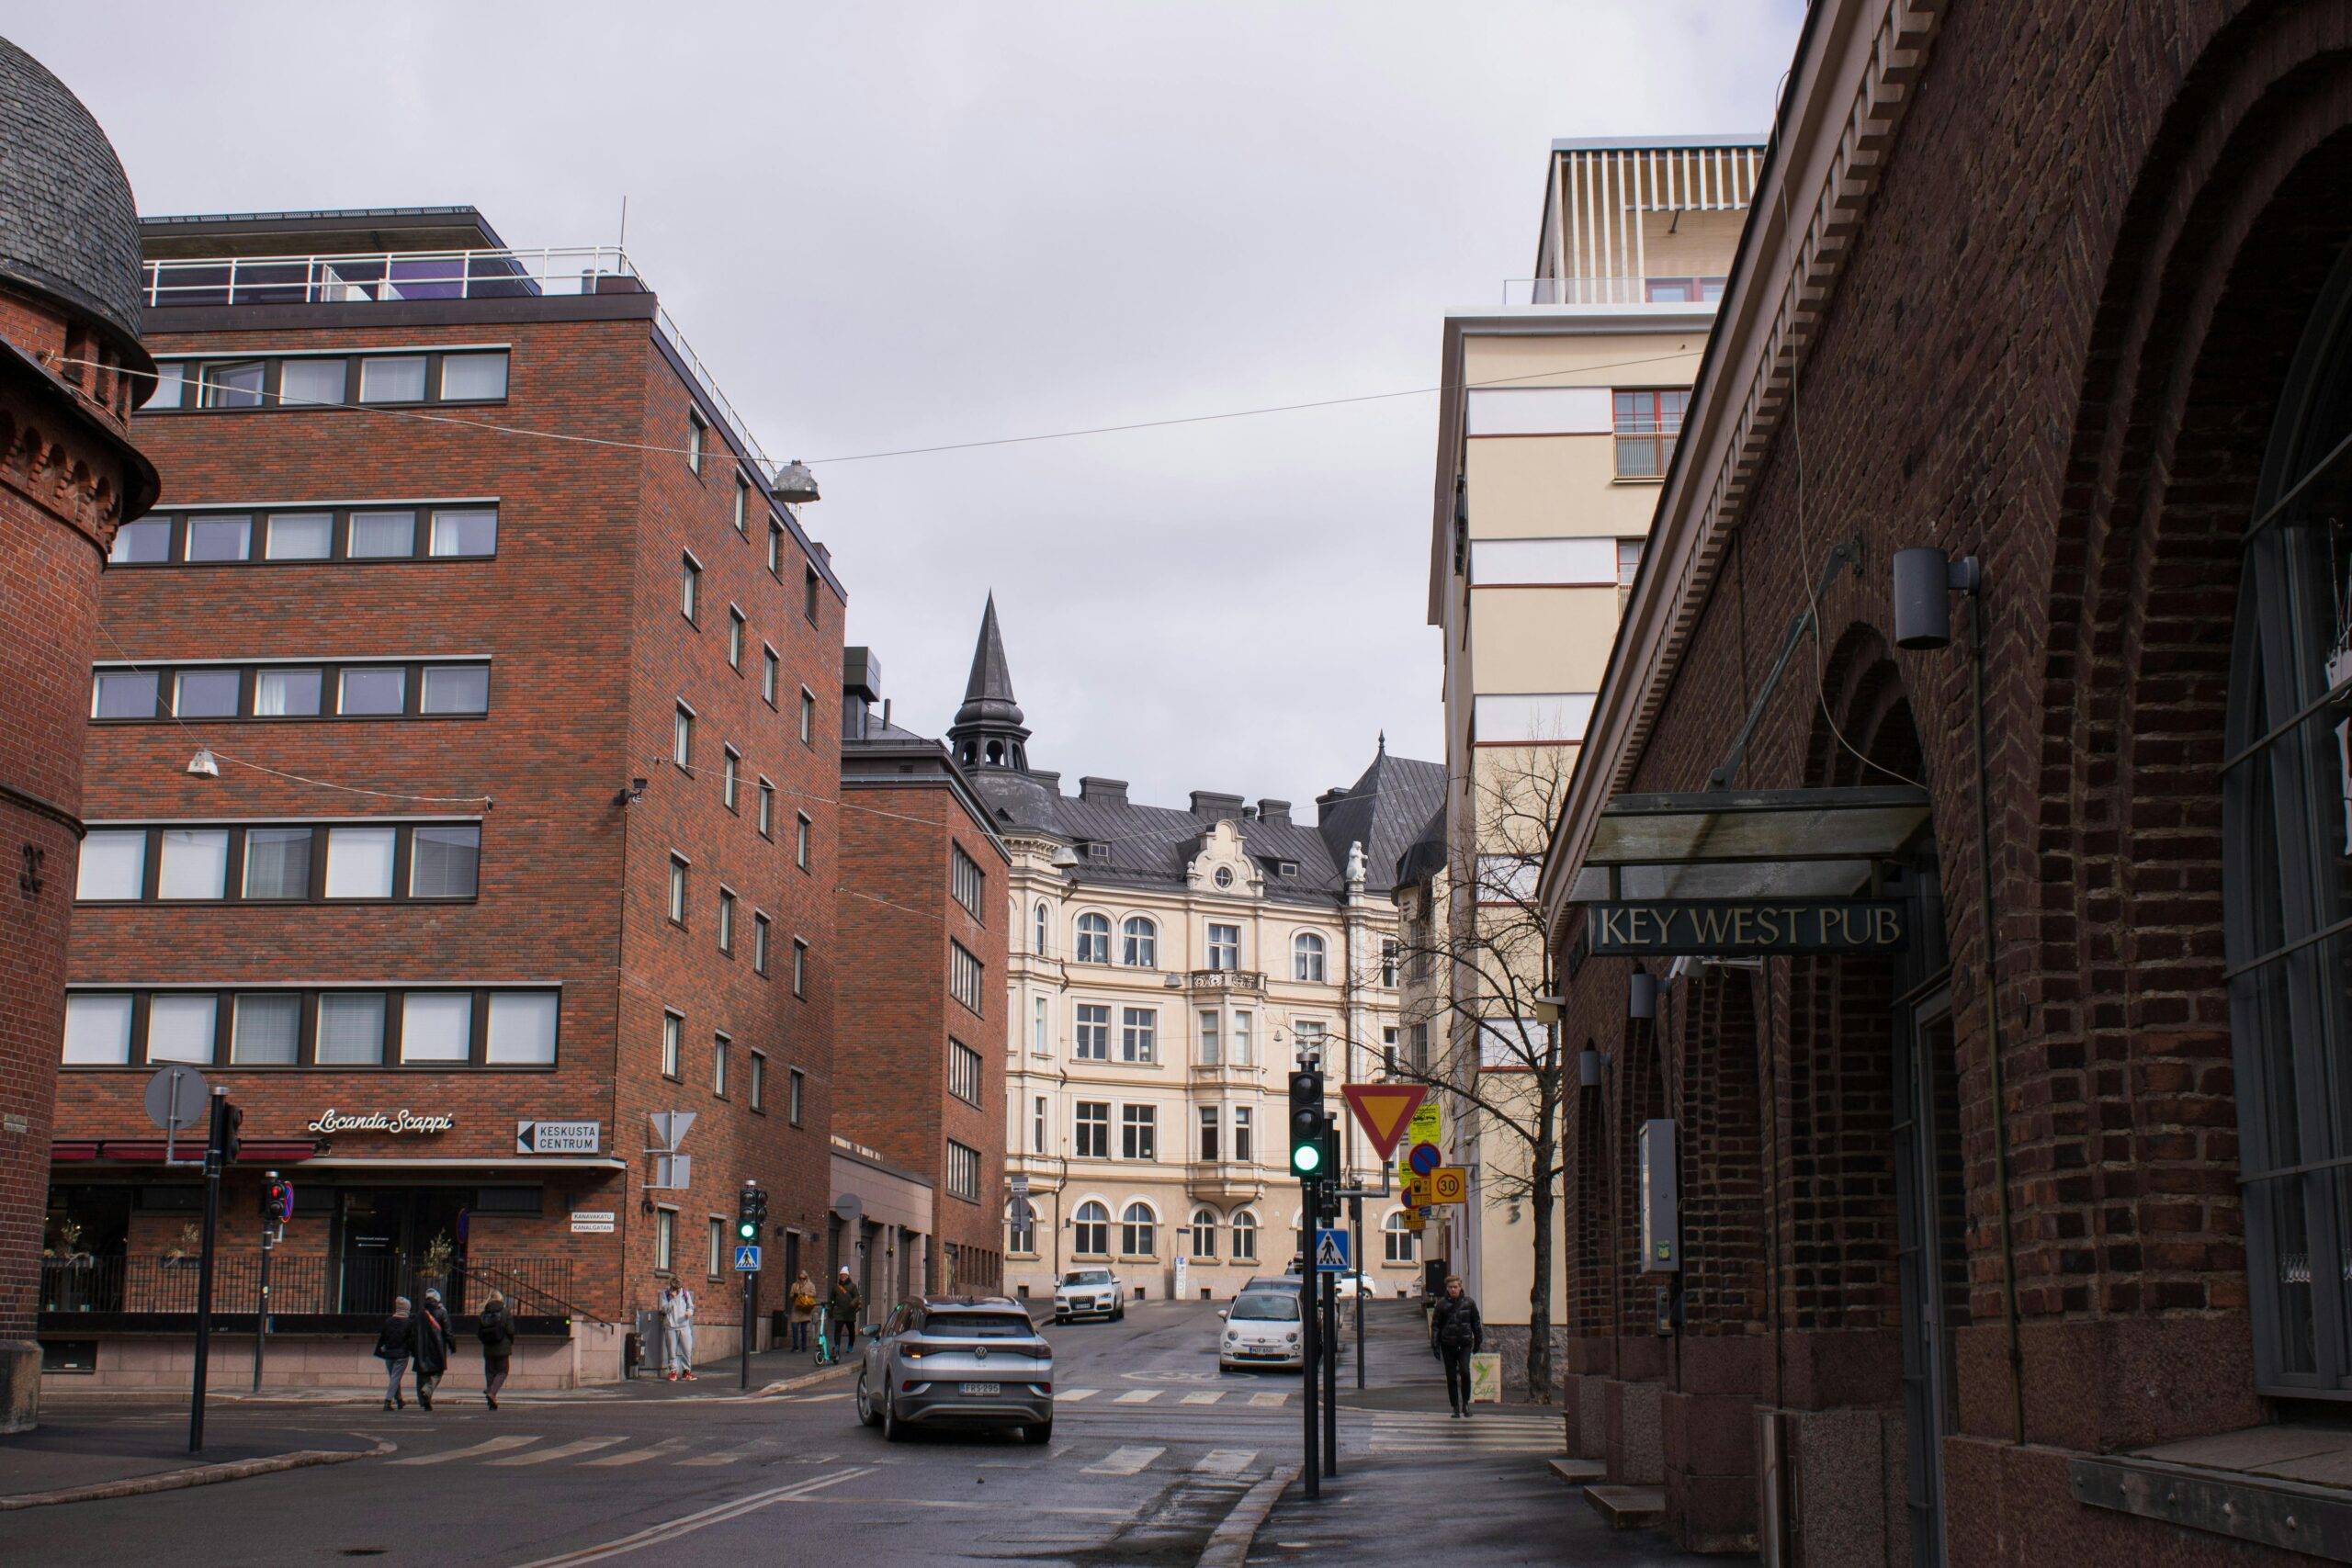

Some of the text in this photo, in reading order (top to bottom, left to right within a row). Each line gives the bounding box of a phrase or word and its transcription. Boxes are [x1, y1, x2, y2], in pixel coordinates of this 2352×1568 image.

[1600, 907, 1901, 946] KEY WEST PUB
[308, 1108, 453, 1134] Locanda Scappi
[540, 1126, 595, 1137] KESKUSTA
[540, 1138, 593, 1149] CENTRUM
[1441, 1179, 1455, 1191] 30
